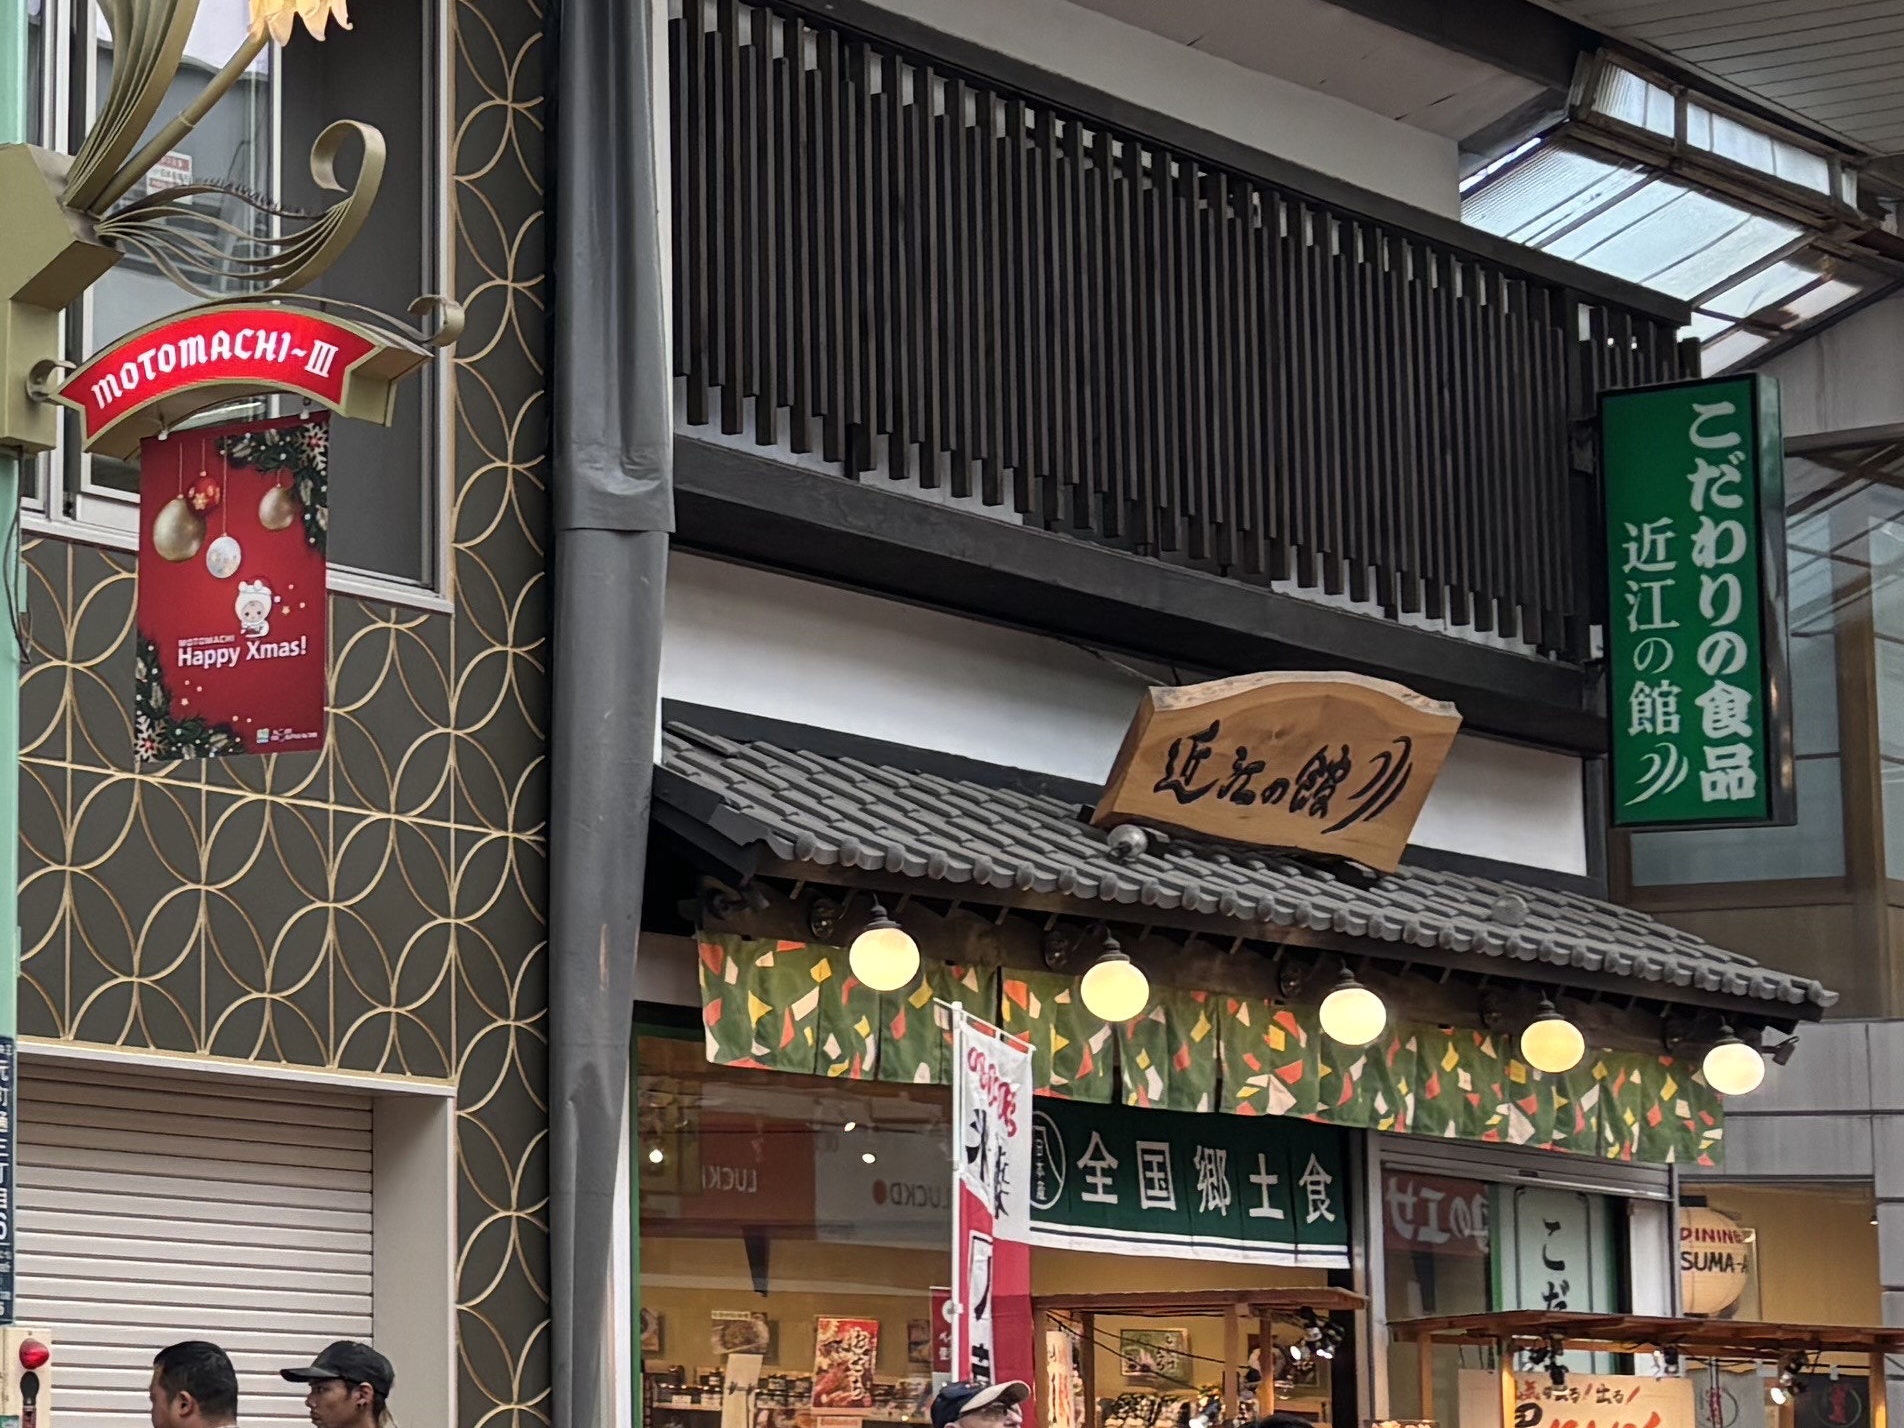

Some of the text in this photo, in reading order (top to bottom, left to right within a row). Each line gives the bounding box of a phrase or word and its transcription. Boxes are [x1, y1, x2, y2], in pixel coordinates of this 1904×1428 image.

[1621, 516, 1683, 737] 近江の館
[1686, 400, 1758, 803] こだわりの食品
[178, 635, 307, 670] Happy Xmas!
[1076, 1129, 1336, 1225] 全国郷土食
[1680, 1226, 1744, 1244] DINING
